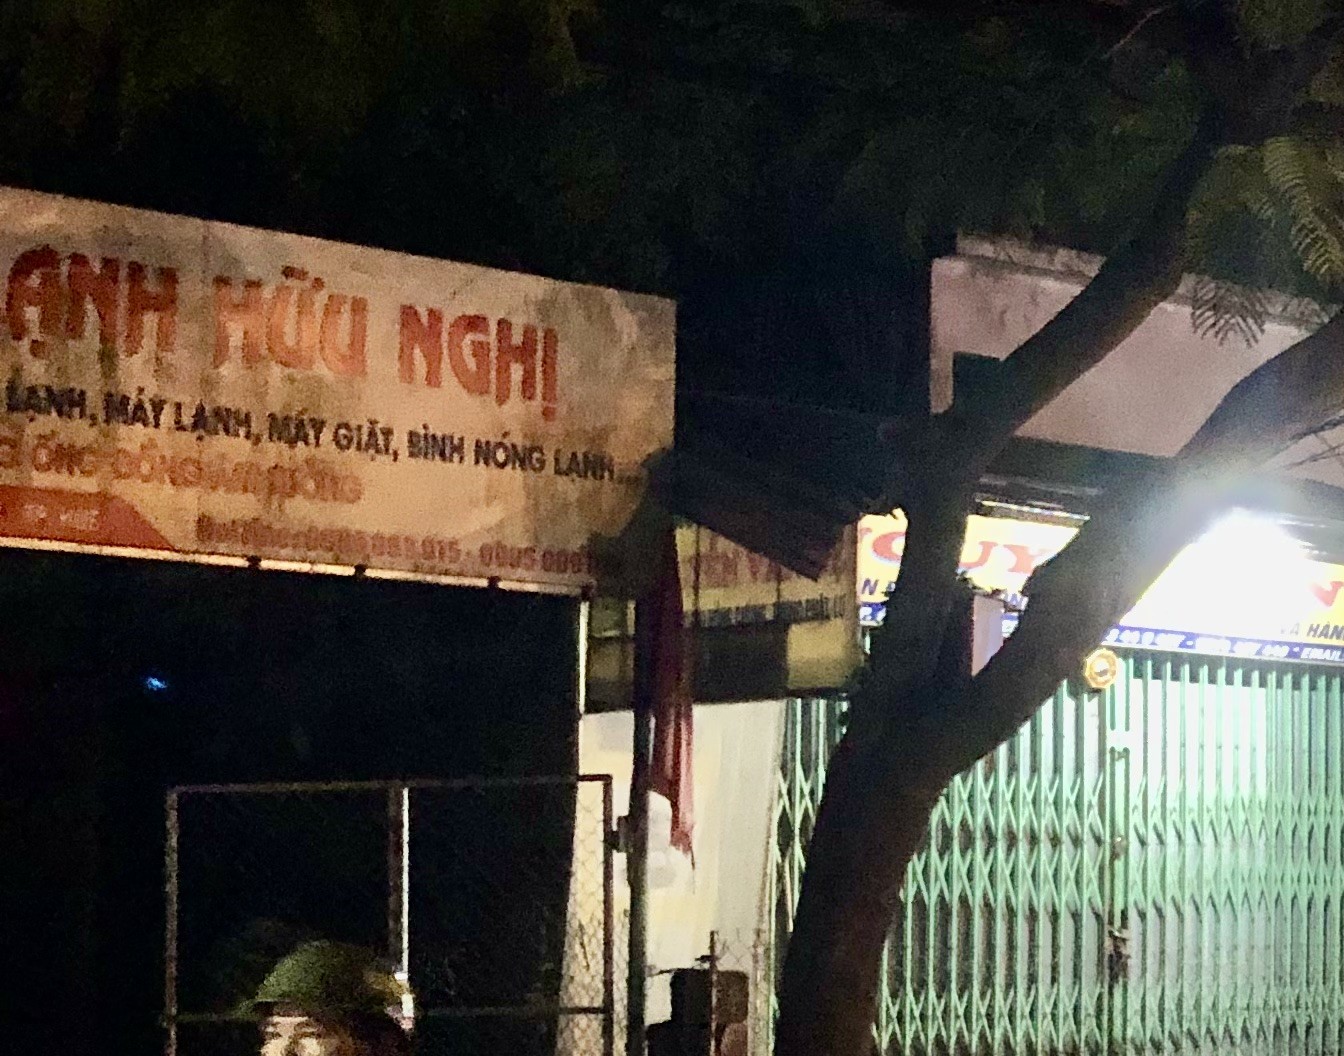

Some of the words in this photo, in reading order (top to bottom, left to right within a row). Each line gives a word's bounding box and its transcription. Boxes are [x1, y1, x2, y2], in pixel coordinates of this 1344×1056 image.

[212, 264, 368, 377] HỮU
[399, 304, 558, 422] NGHỊ
[174, 399, 262, 447] LẠNH,
[407, 423, 465, 464] BÌNH
